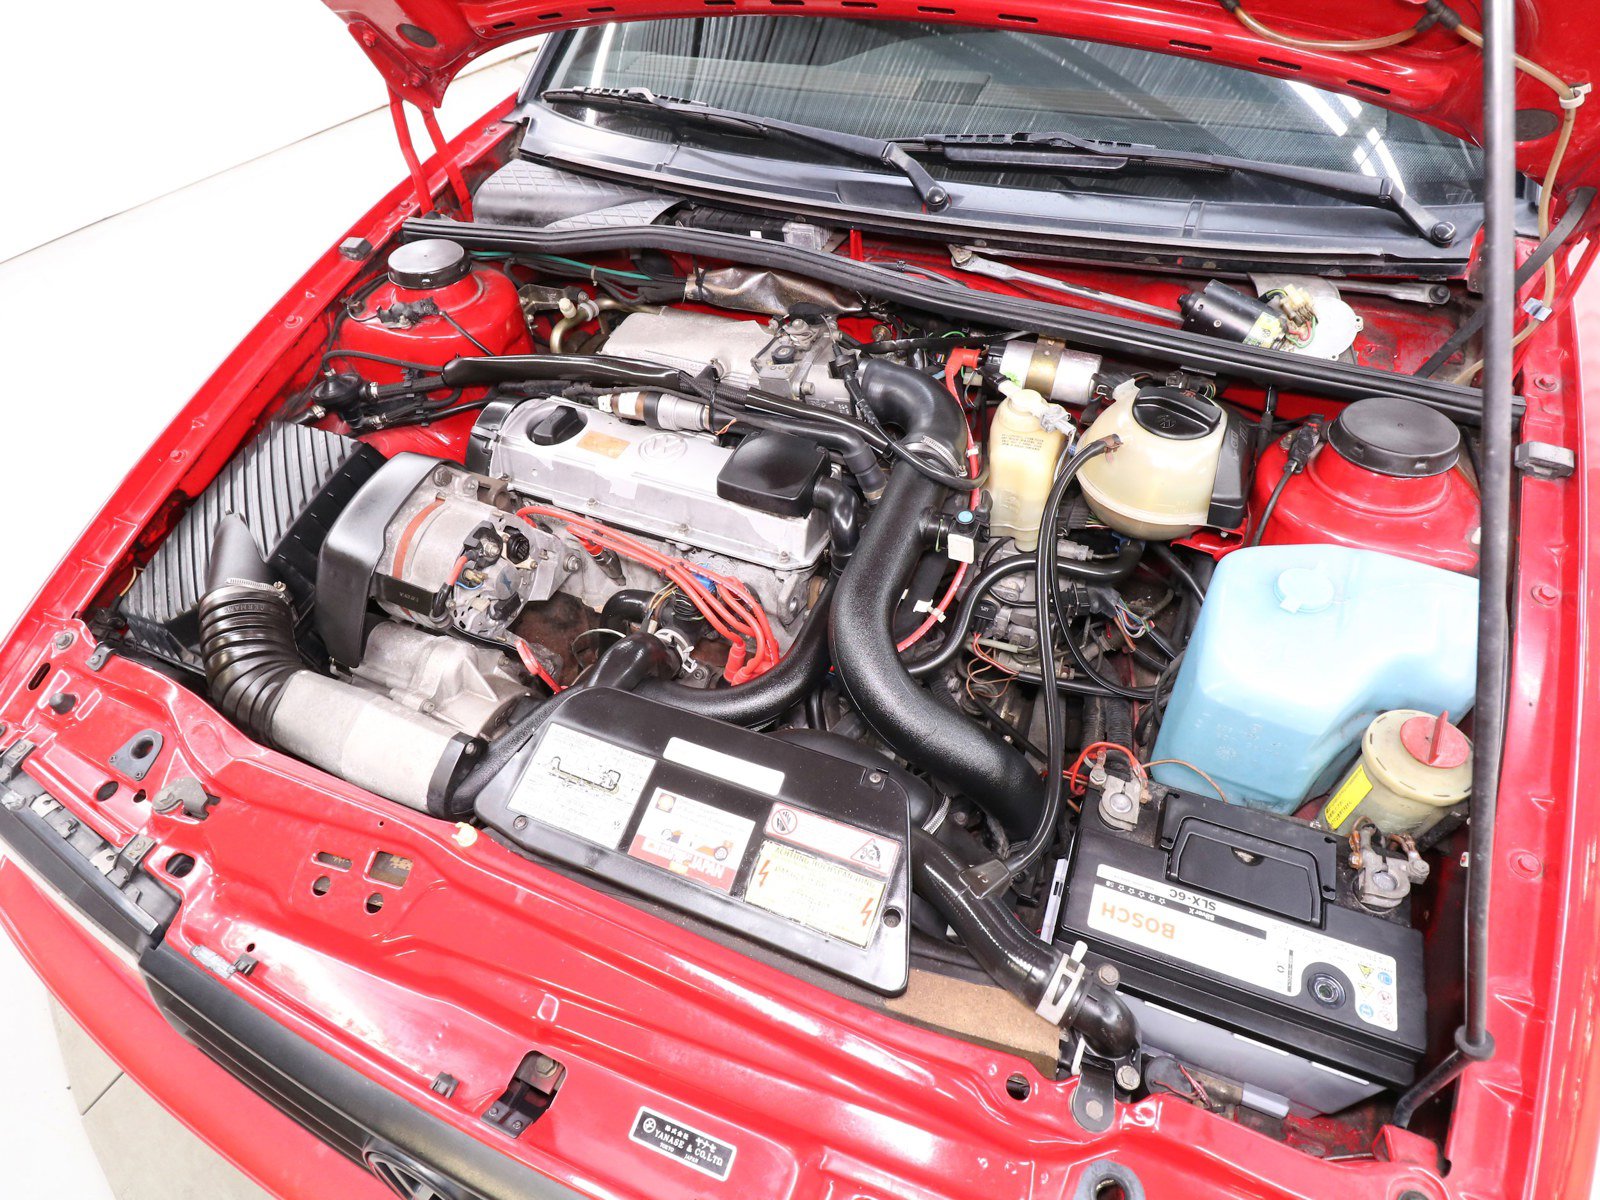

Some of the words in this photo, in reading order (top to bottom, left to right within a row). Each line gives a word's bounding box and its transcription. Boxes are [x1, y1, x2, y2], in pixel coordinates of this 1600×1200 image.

[1169, 888, 1216, 911] SLX-6C
[1101, 901, 1176, 939] BOSCH
[655, 1129, 685, 1149] YANASE
[686, 1143, 693, 1153] &
[684, 1153, 700, 1164] JAPAN
